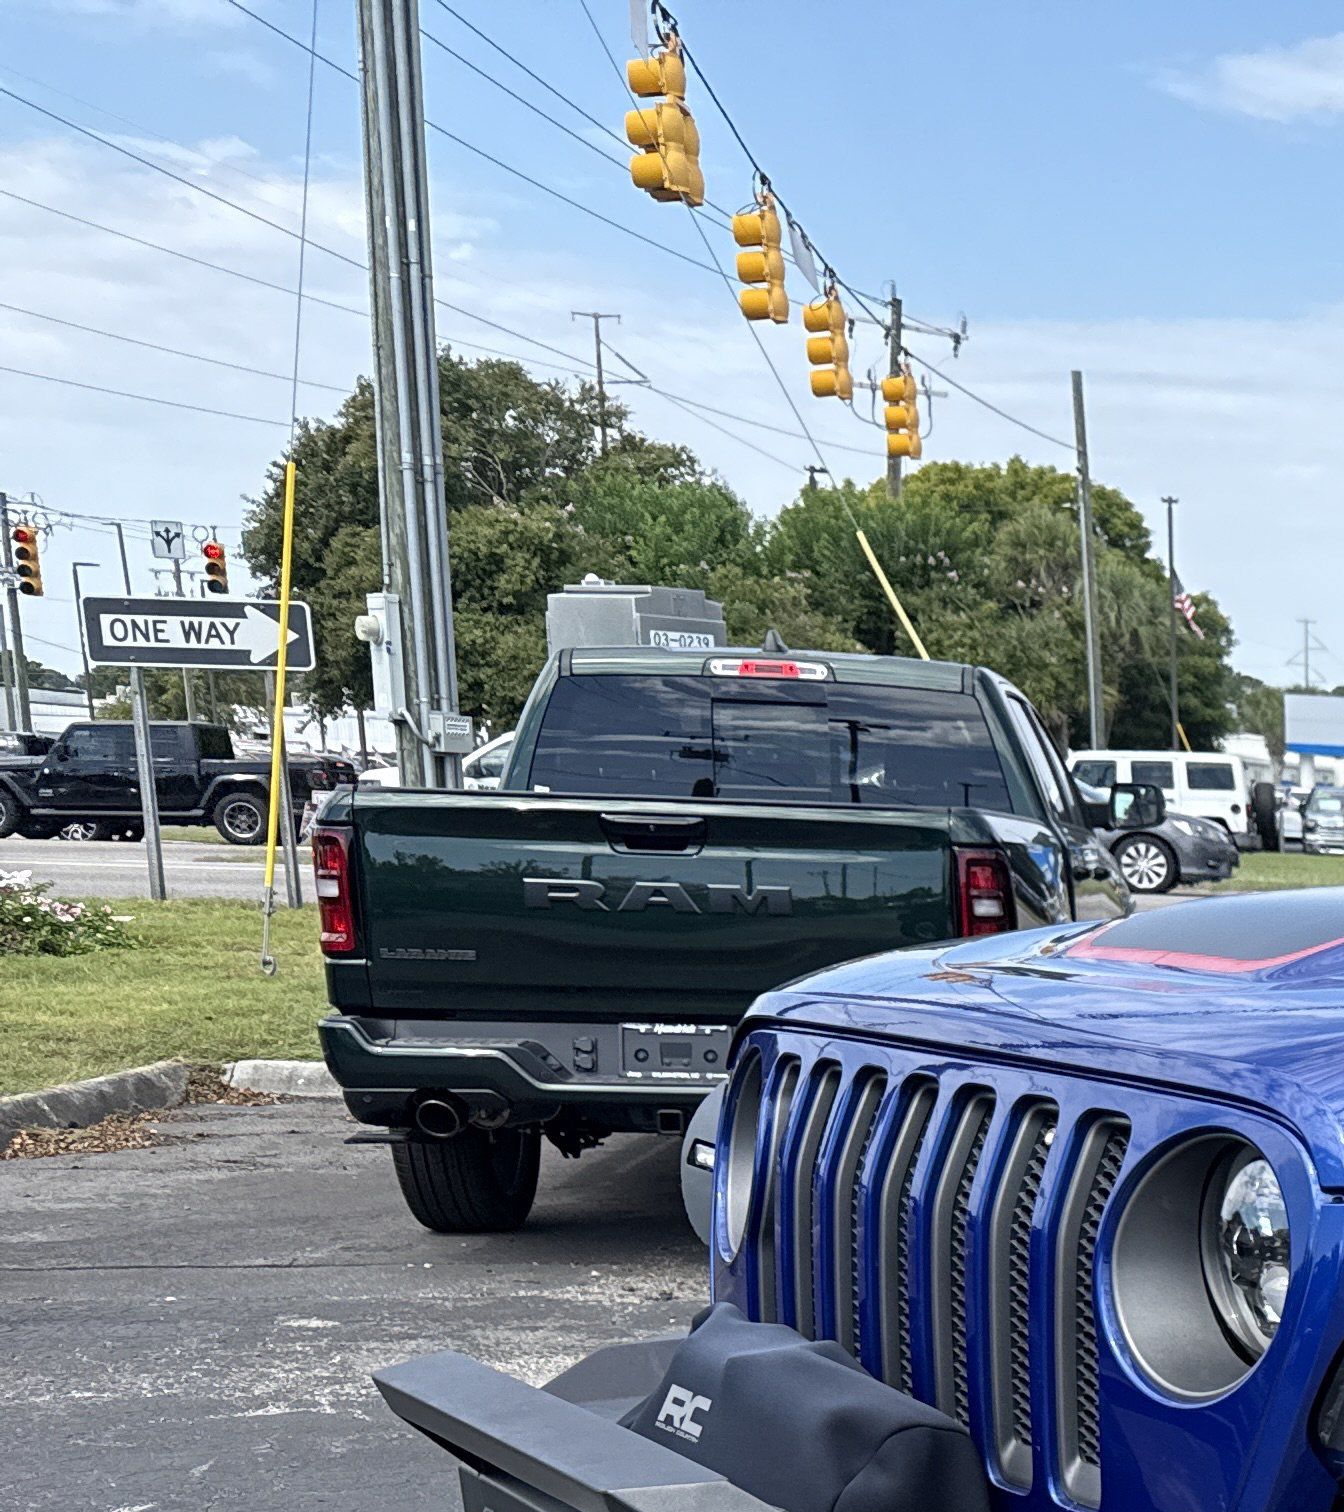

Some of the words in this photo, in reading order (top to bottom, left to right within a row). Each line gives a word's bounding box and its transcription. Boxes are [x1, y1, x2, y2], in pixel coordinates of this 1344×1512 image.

[109, 618, 170, 643] ONE
[180, 620, 241, 645] WAY
[522, 877, 794, 916] RAM
[657, 1383, 712, 1438] RC
